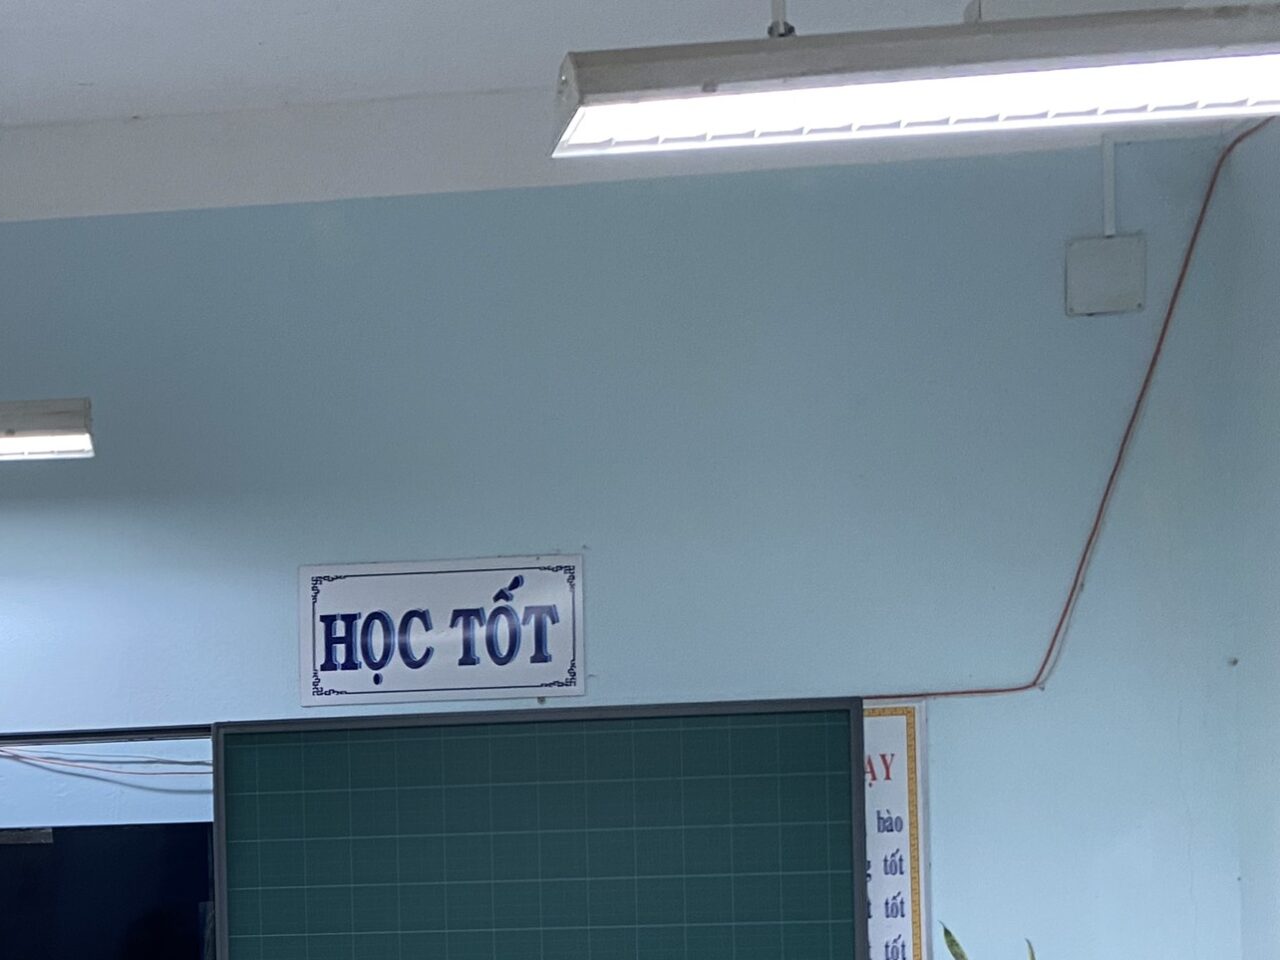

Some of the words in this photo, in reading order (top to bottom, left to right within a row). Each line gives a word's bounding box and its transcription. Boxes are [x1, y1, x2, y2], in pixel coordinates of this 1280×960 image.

[319, 608, 434, 685] HỌC
[449, 574, 560, 667] TỐT
[864, 752, 896, 788] ẠY
[876, 808, 904, 834] bào
[883, 847, 905, 876] tốt
[884, 890, 906, 919] tốt
